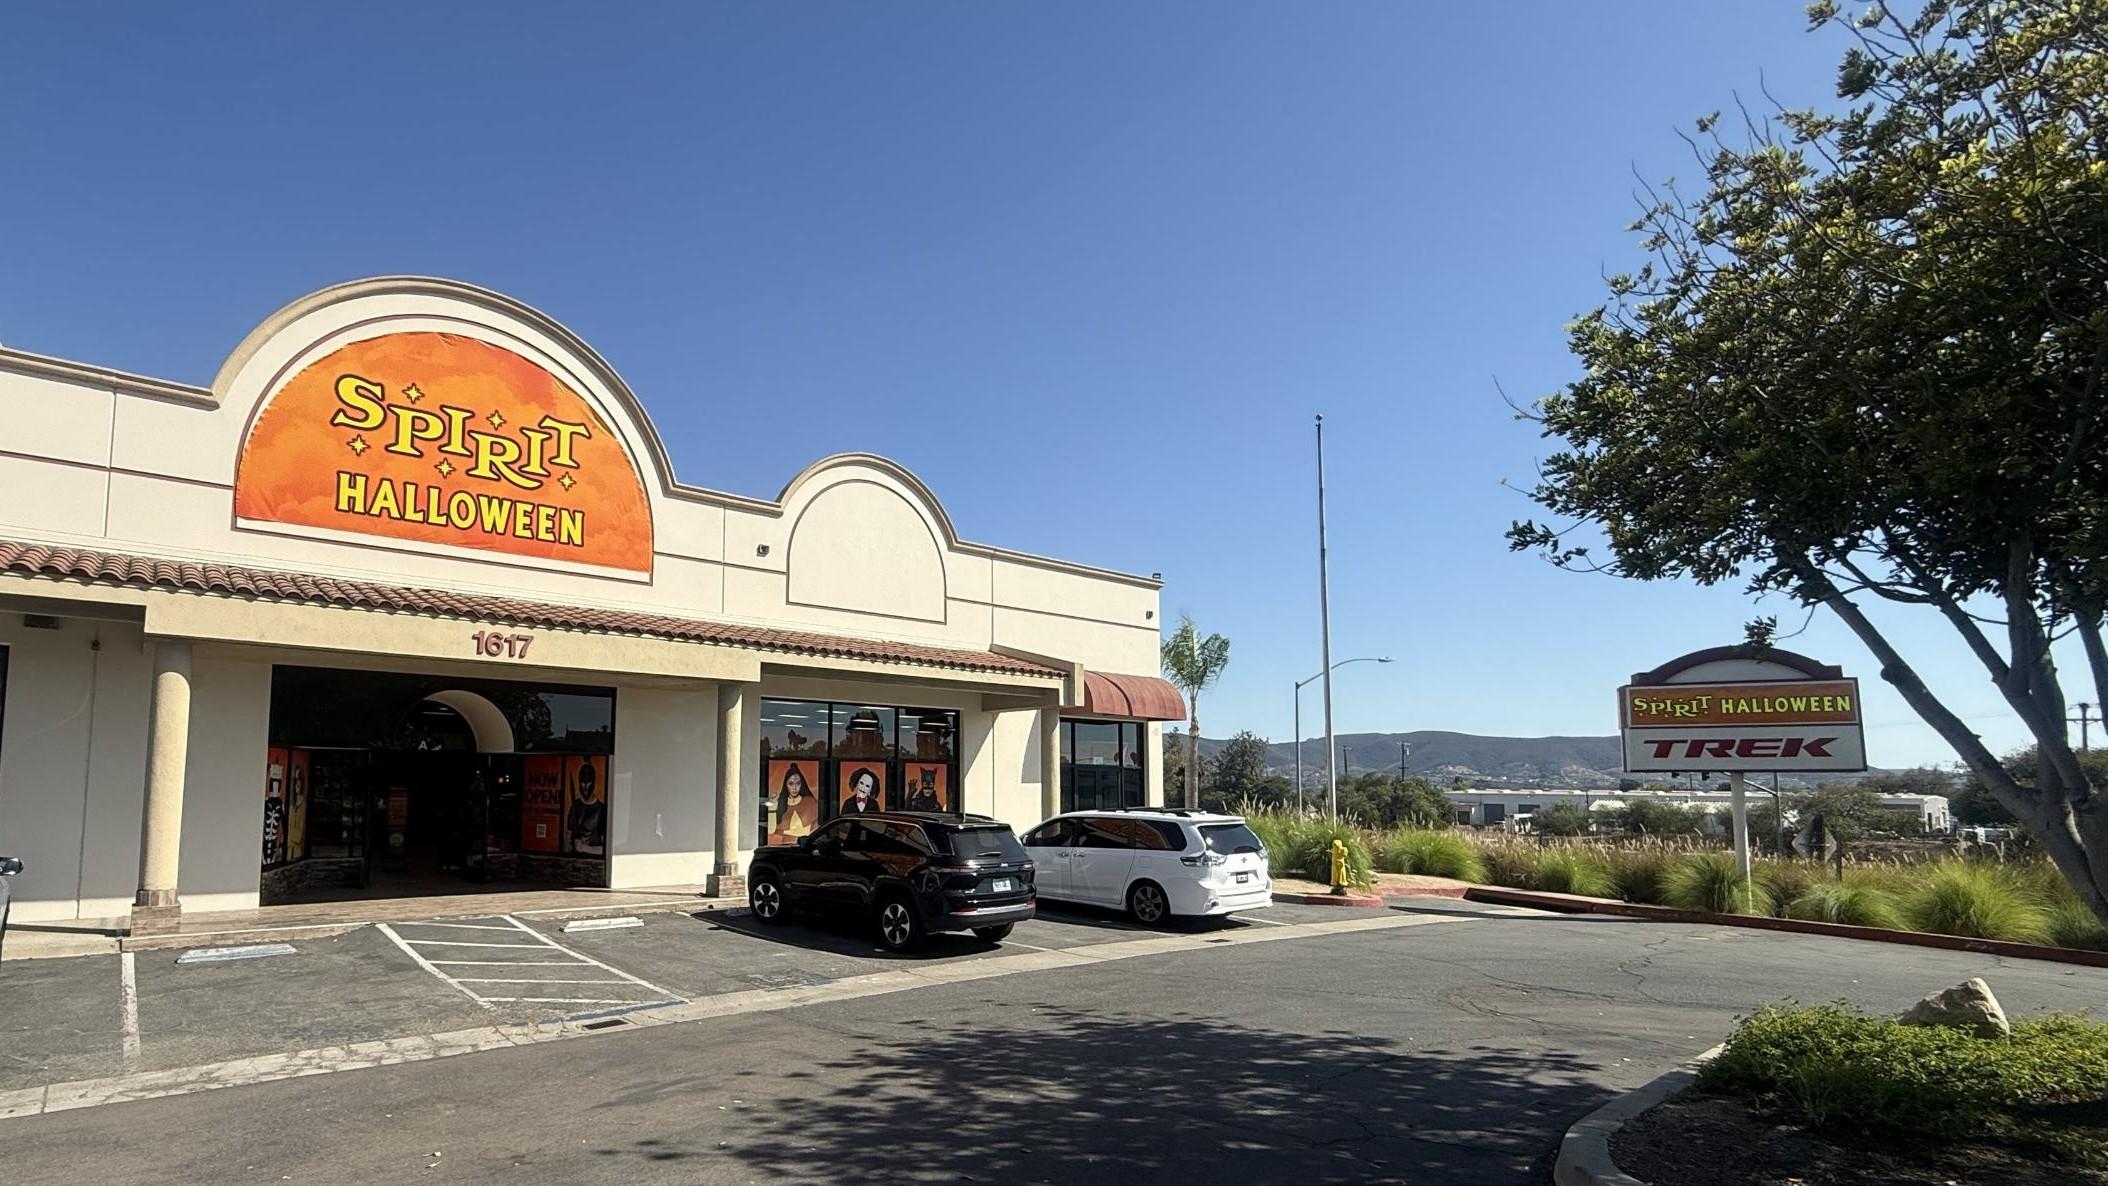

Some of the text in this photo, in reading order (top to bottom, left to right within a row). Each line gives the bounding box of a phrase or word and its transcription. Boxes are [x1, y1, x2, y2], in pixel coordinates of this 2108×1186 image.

[331, 374, 591, 489] SPIRIT
[335, 470, 585, 547] HALLOWEEN
[472, 630, 535, 659] 1617
[1633, 695, 1851, 718] SPIRIT HALLOWEEN
[1643, 737, 1839, 758] TREK
